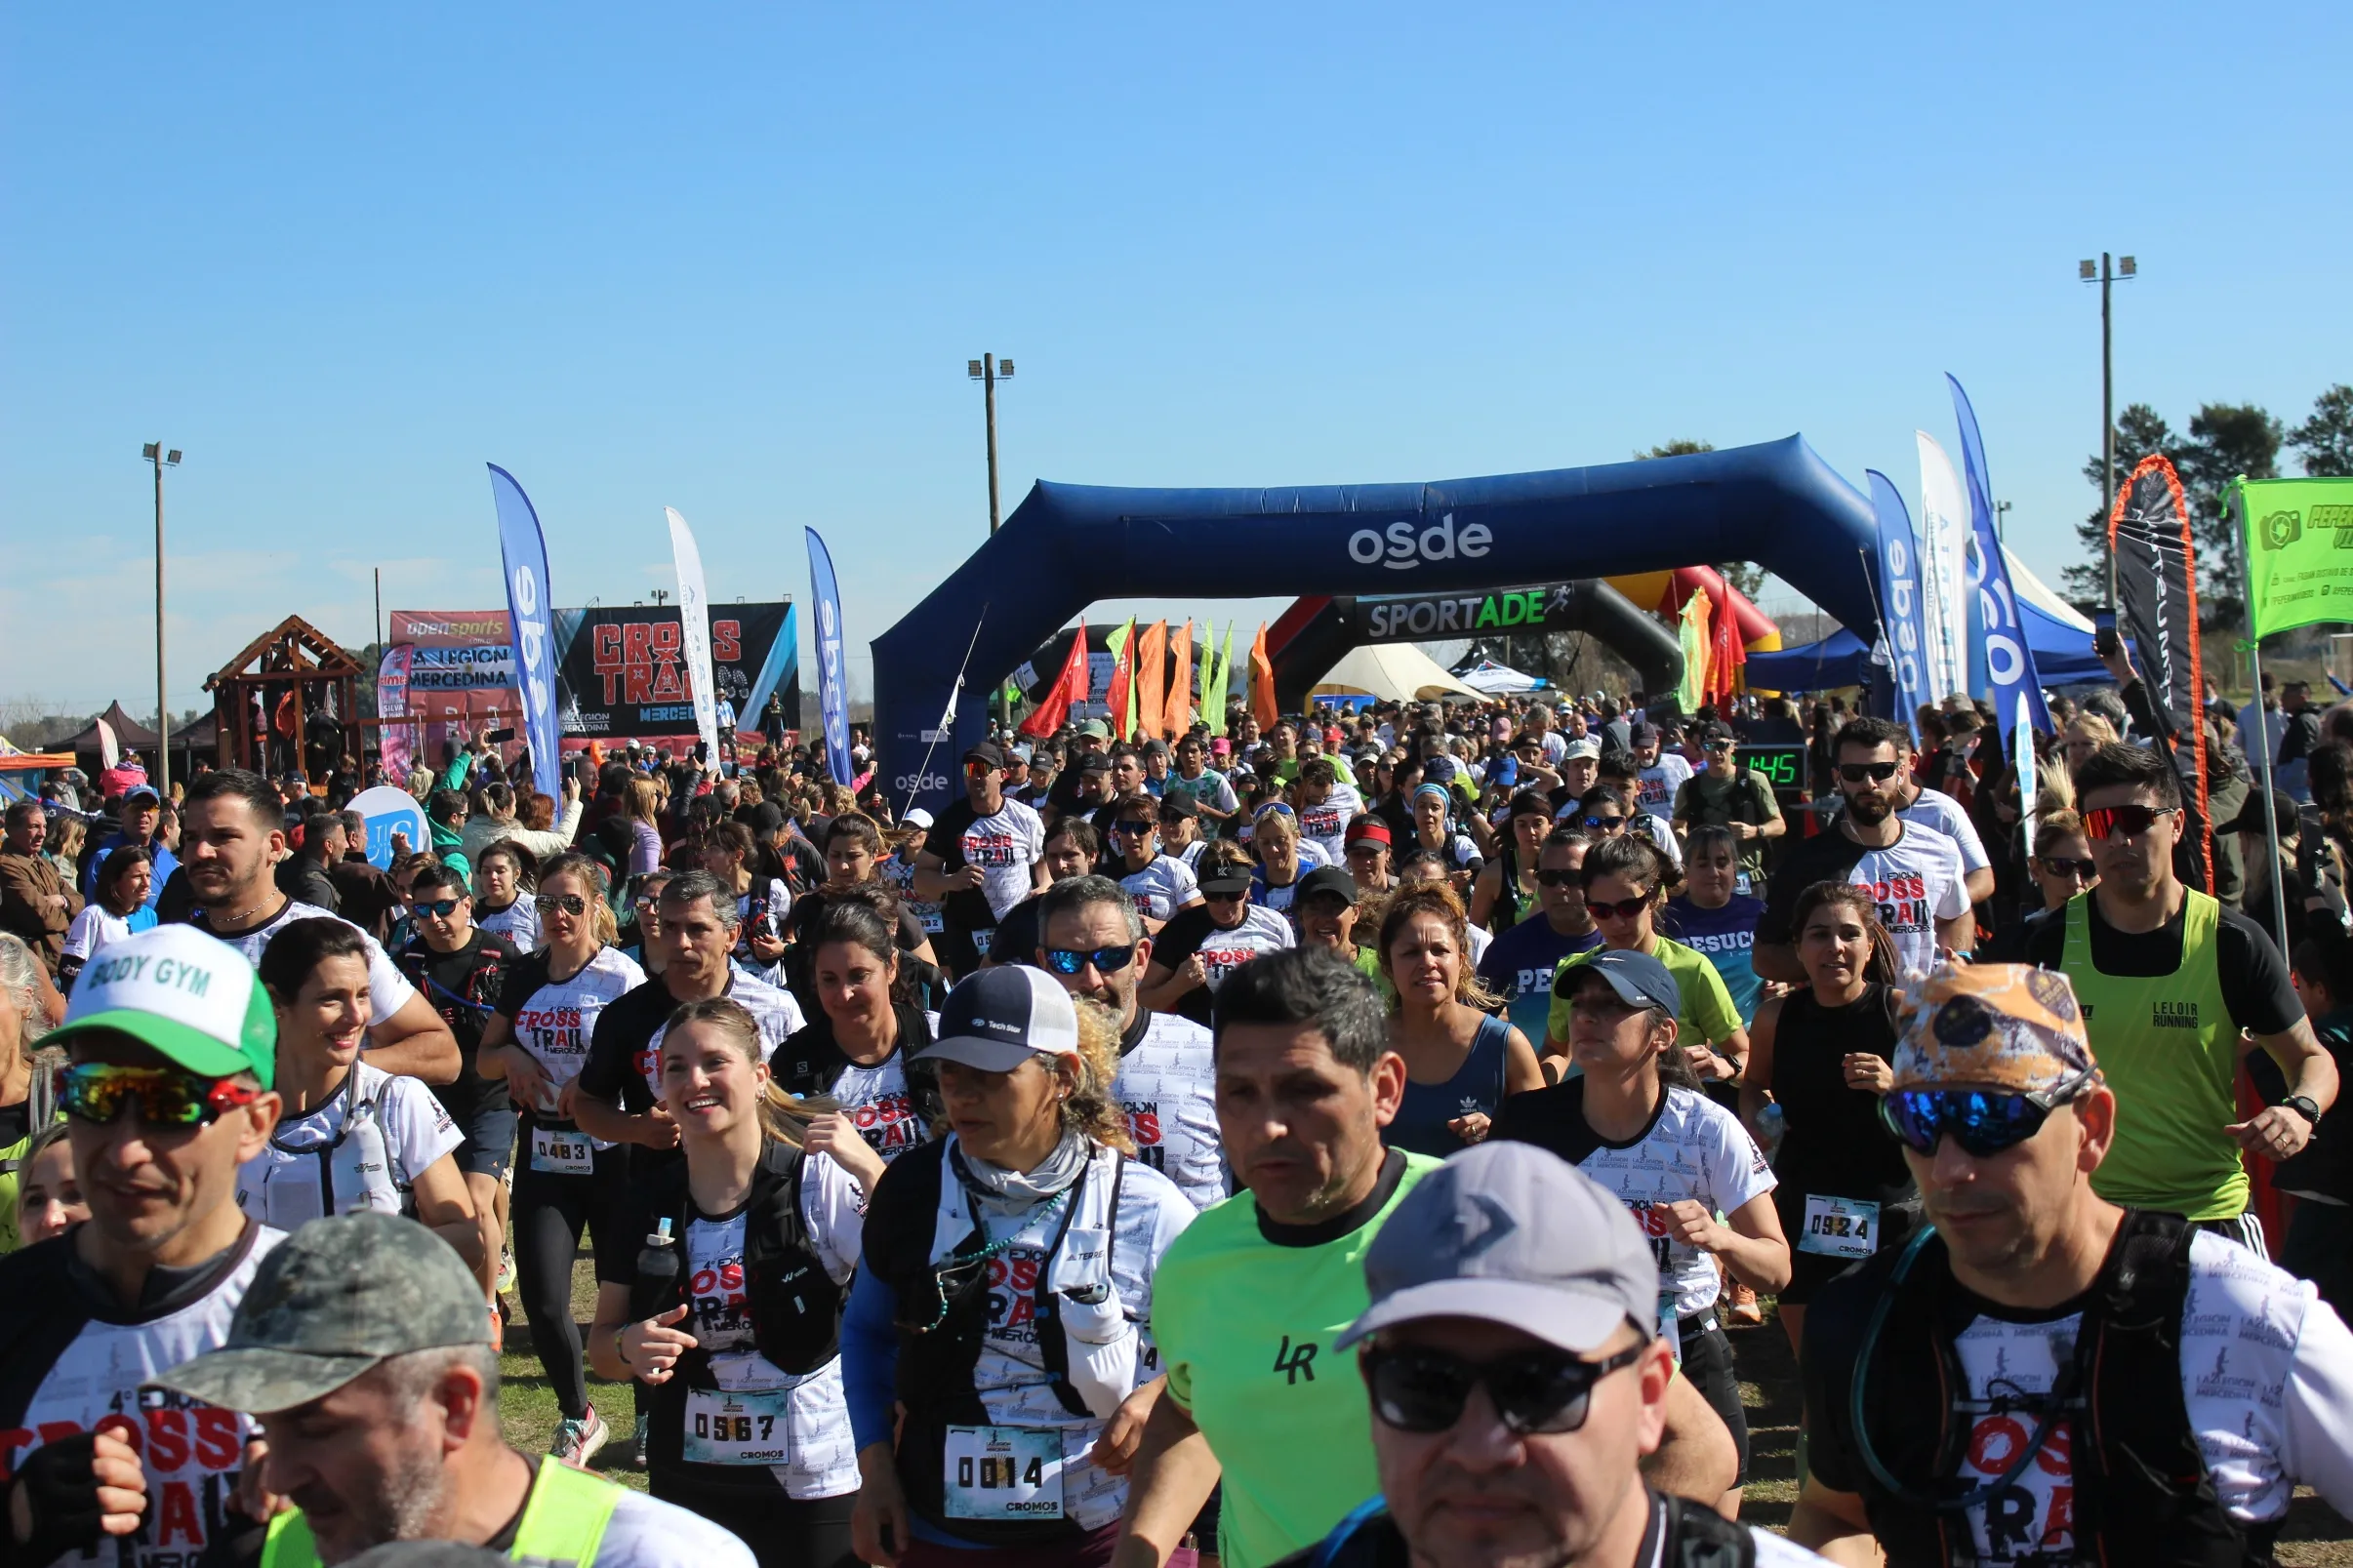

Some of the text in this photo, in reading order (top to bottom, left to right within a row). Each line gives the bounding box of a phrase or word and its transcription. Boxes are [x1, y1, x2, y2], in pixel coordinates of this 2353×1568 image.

[1348, 512, 1493, 570] osde
[1368, 591, 1546, 637] SPORTADE
[406, 620, 504, 637] opensports
[593, 620, 741, 664] CROS
[439, 649, 508, 664] LEGION
[410, 671, 508, 687] MERCEDINA
[384, 704, 404, 712] SILVA
[895, 772, 949, 793] osde
[956, 835, 1012, 851] CROSS
[154, 958, 212, 998] GYM
[2153, 1001, 2198, 1016] LELOIR
[515, 1011, 581, 1032] CROSS
[2153, 1015, 2198, 1028] RUNNING
[531, 1027, 587, 1051] TRAIL
[1078, 1250, 1105, 1261] TERRE
[1839, 1245, 1873, 1255] CROMOS
[696, 1412, 775, 1442] 0567
[741, 1450, 785, 1459] CROMOS
[1006, 1502, 1058, 1511] CROMOS
